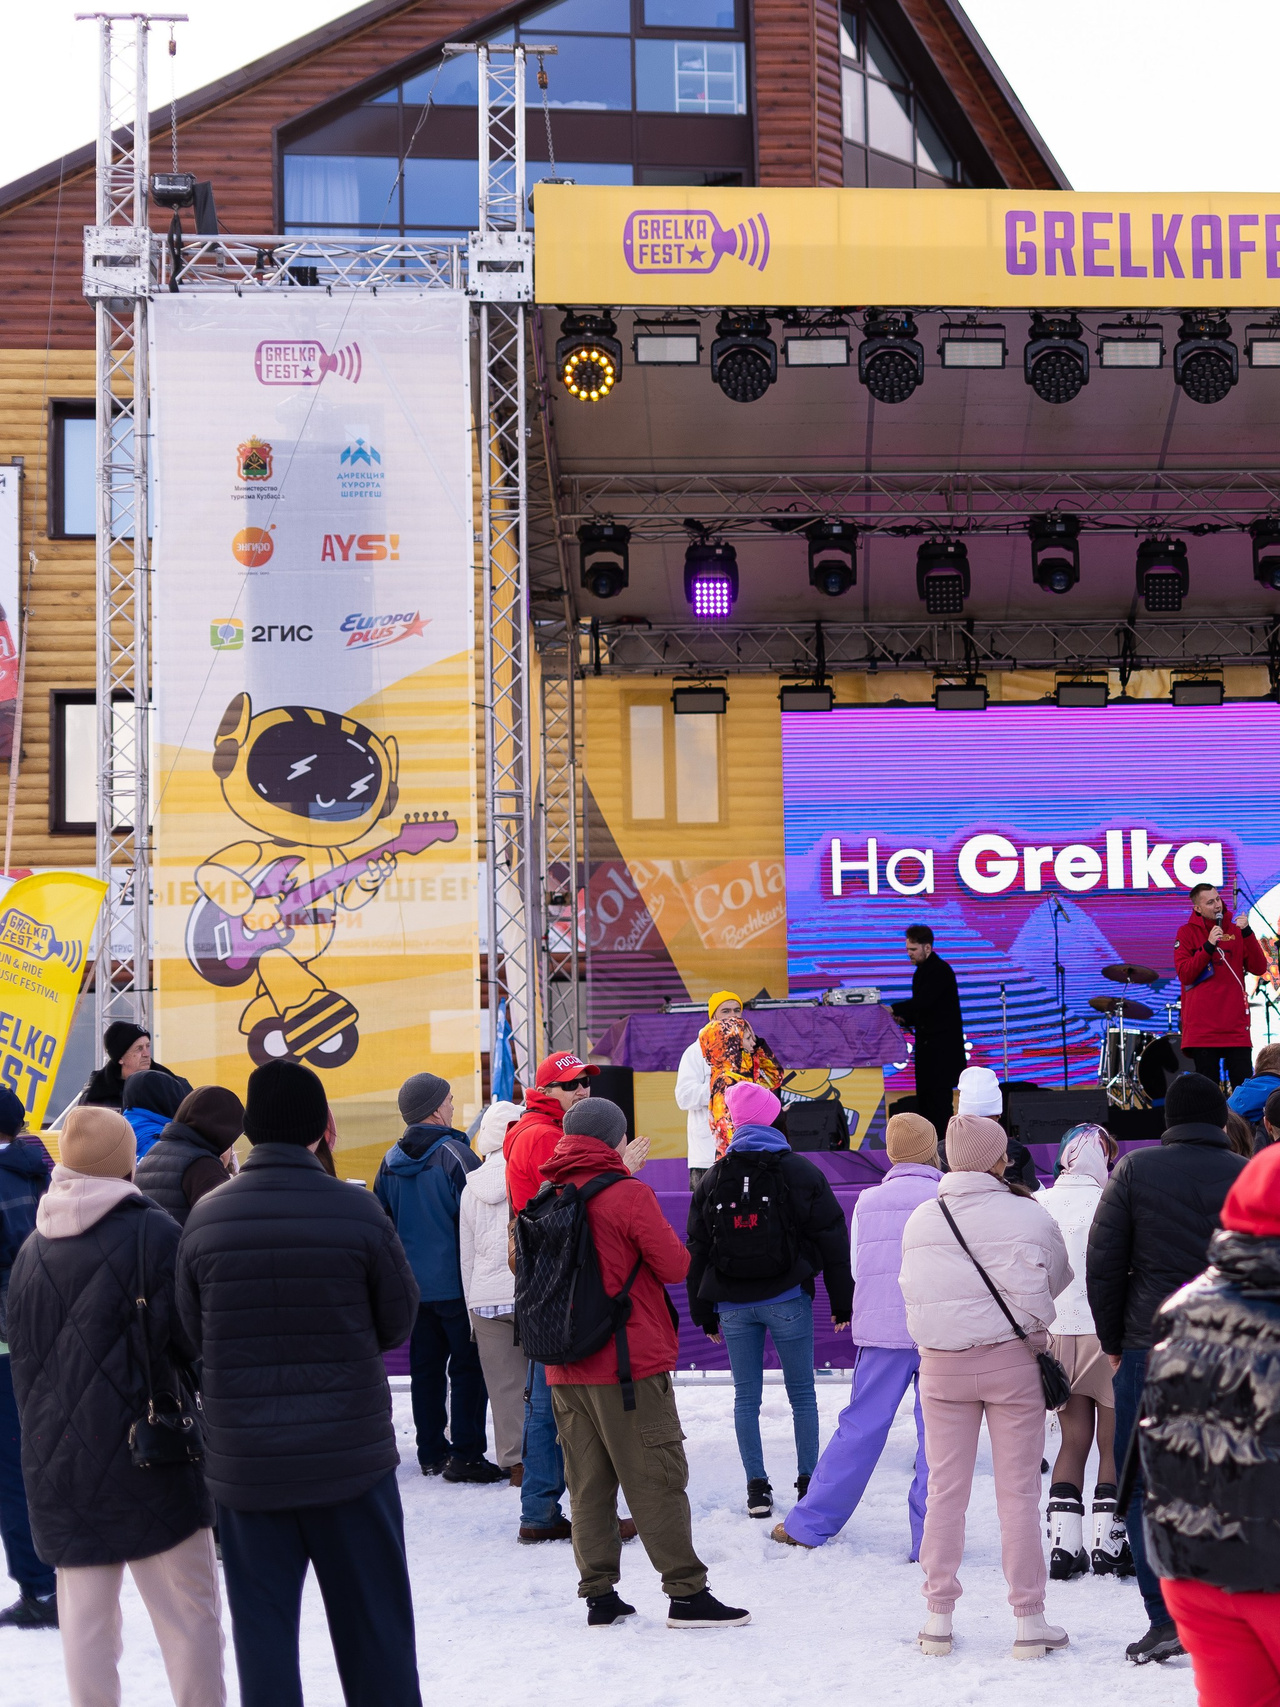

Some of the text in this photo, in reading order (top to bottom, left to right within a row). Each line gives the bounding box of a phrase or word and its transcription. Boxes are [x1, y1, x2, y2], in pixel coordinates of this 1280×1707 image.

[637, 218, 708, 242] GRELKA
[638, 243, 687, 266] FEST
[265, 346, 316, 362] GRELKA
[265, 364, 300, 379] FEST
[336, 472, 385, 481] ДИРЕКЦИЯ
[341, 481, 381, 489] КУРОРТА
[230, 493, 256, 501] туризма
[340, 490, 382, 498] ШЕРЕГЕШ
[320, 534, 400, 562] AYS!
[251, 624, 313, 643] 2ГИС
[957, 828, 1224, 895] Grelka
[694, 860, 786, 924] Cola
[9, 914, 49, 941] GRELKA
[2, 928, 33, 949] FEST
[21, 960, 44, 979] RIDE
[20, 975, 60, 1004] FESTIVAL
